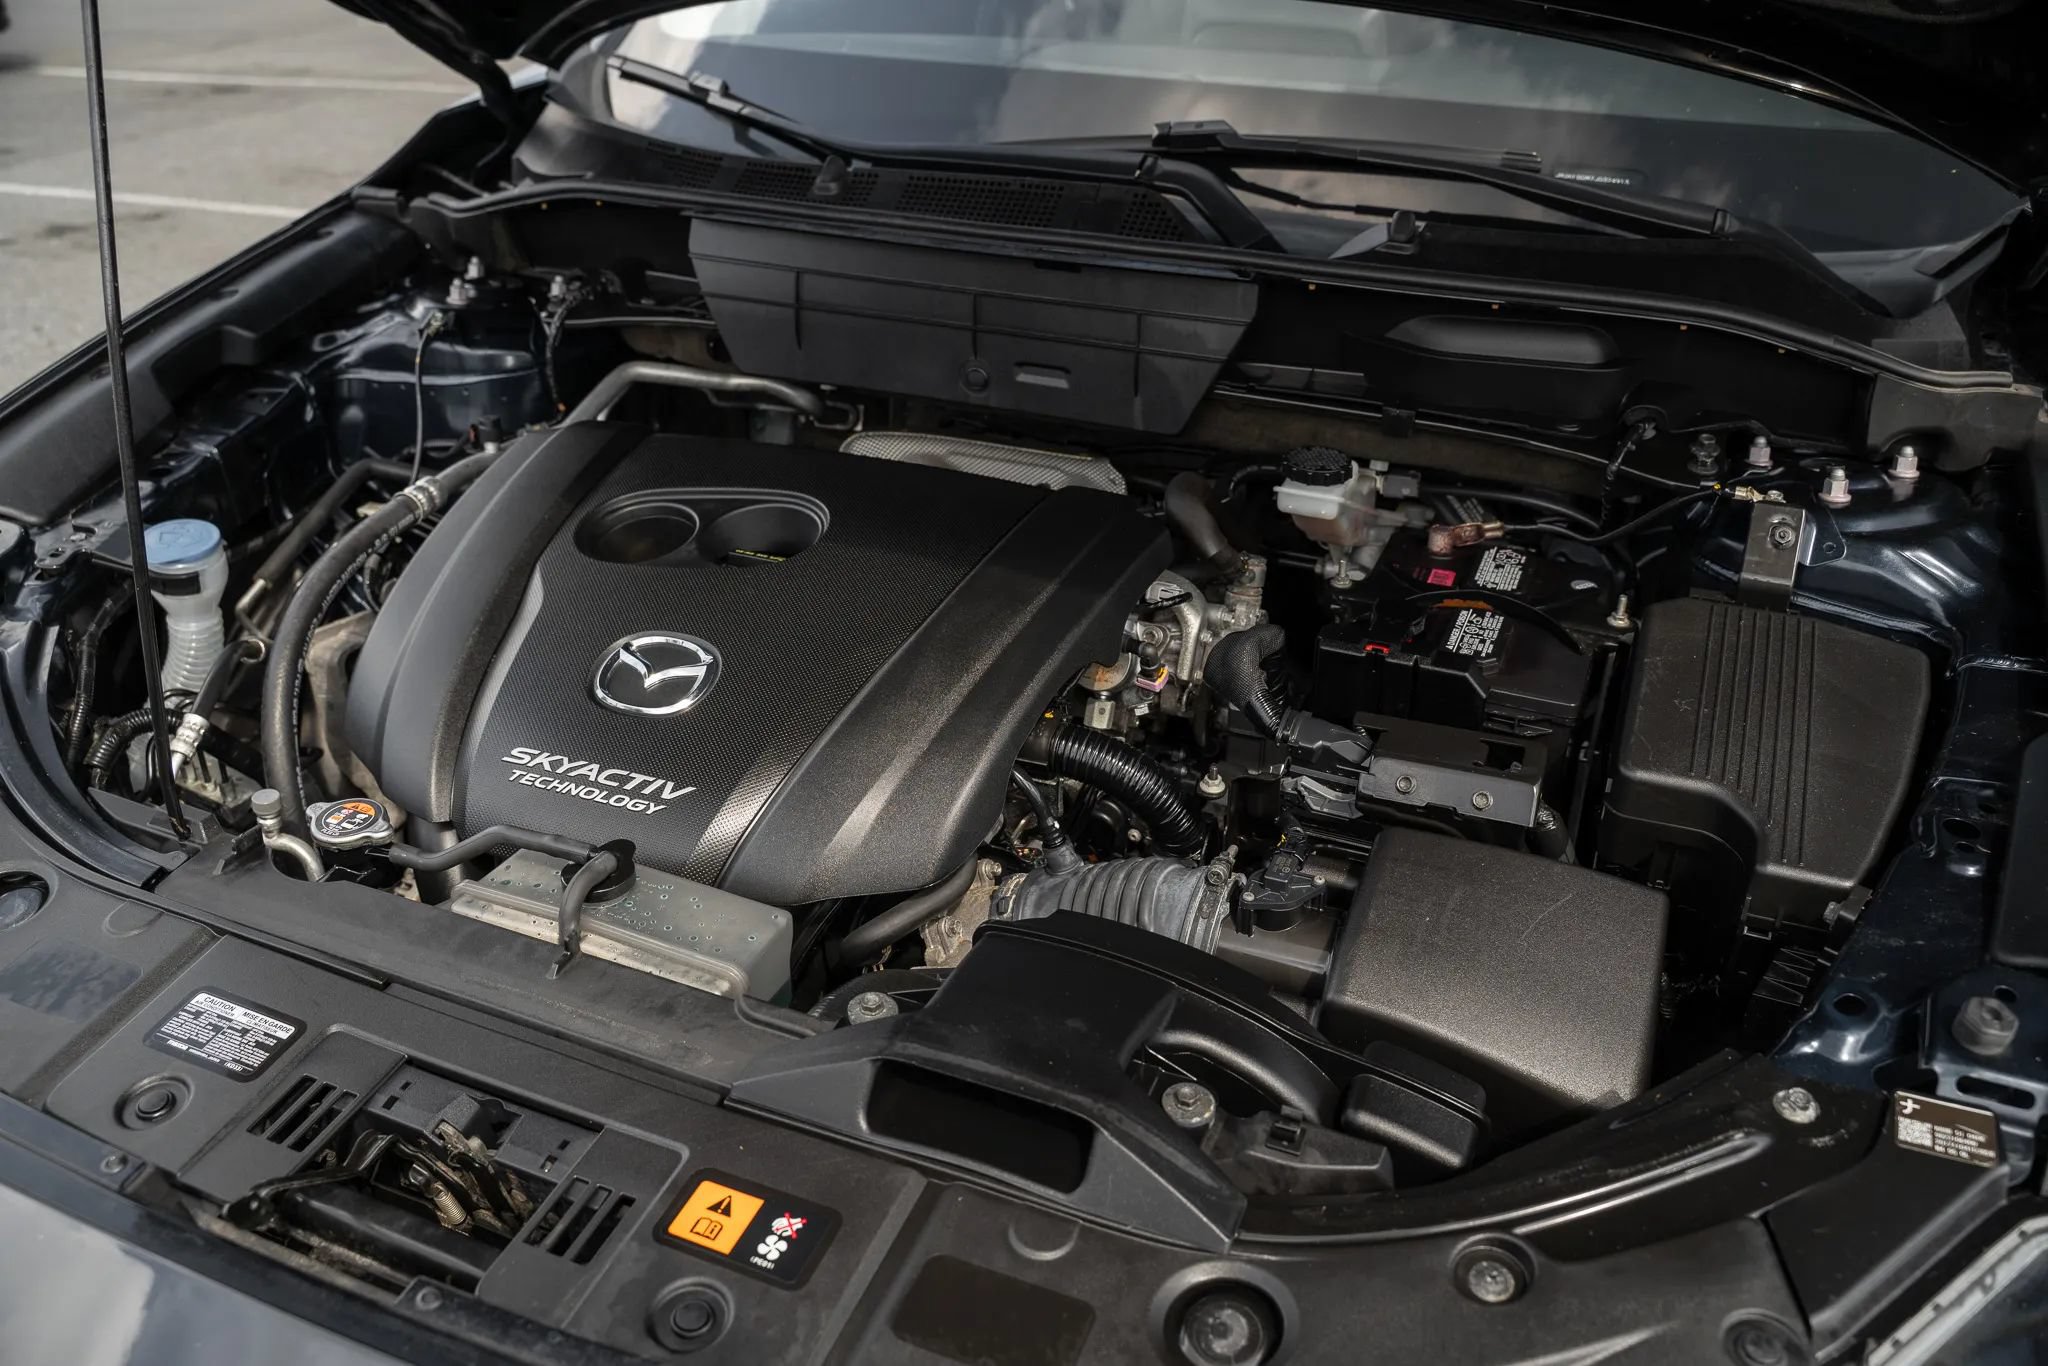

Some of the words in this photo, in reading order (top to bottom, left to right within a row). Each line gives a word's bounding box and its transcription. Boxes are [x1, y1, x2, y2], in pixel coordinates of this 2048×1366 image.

[501, 747, 697, 800] SKYACTIV
[508, 769, 667, 815] TECHNOLOGY
[203, 997, 236, 1012] CAUTION
[243, 1011, 259, 1022] MISE
[259, 1017, 270, 1026] EN
[268, 1020, 293, 1034] GARDE
